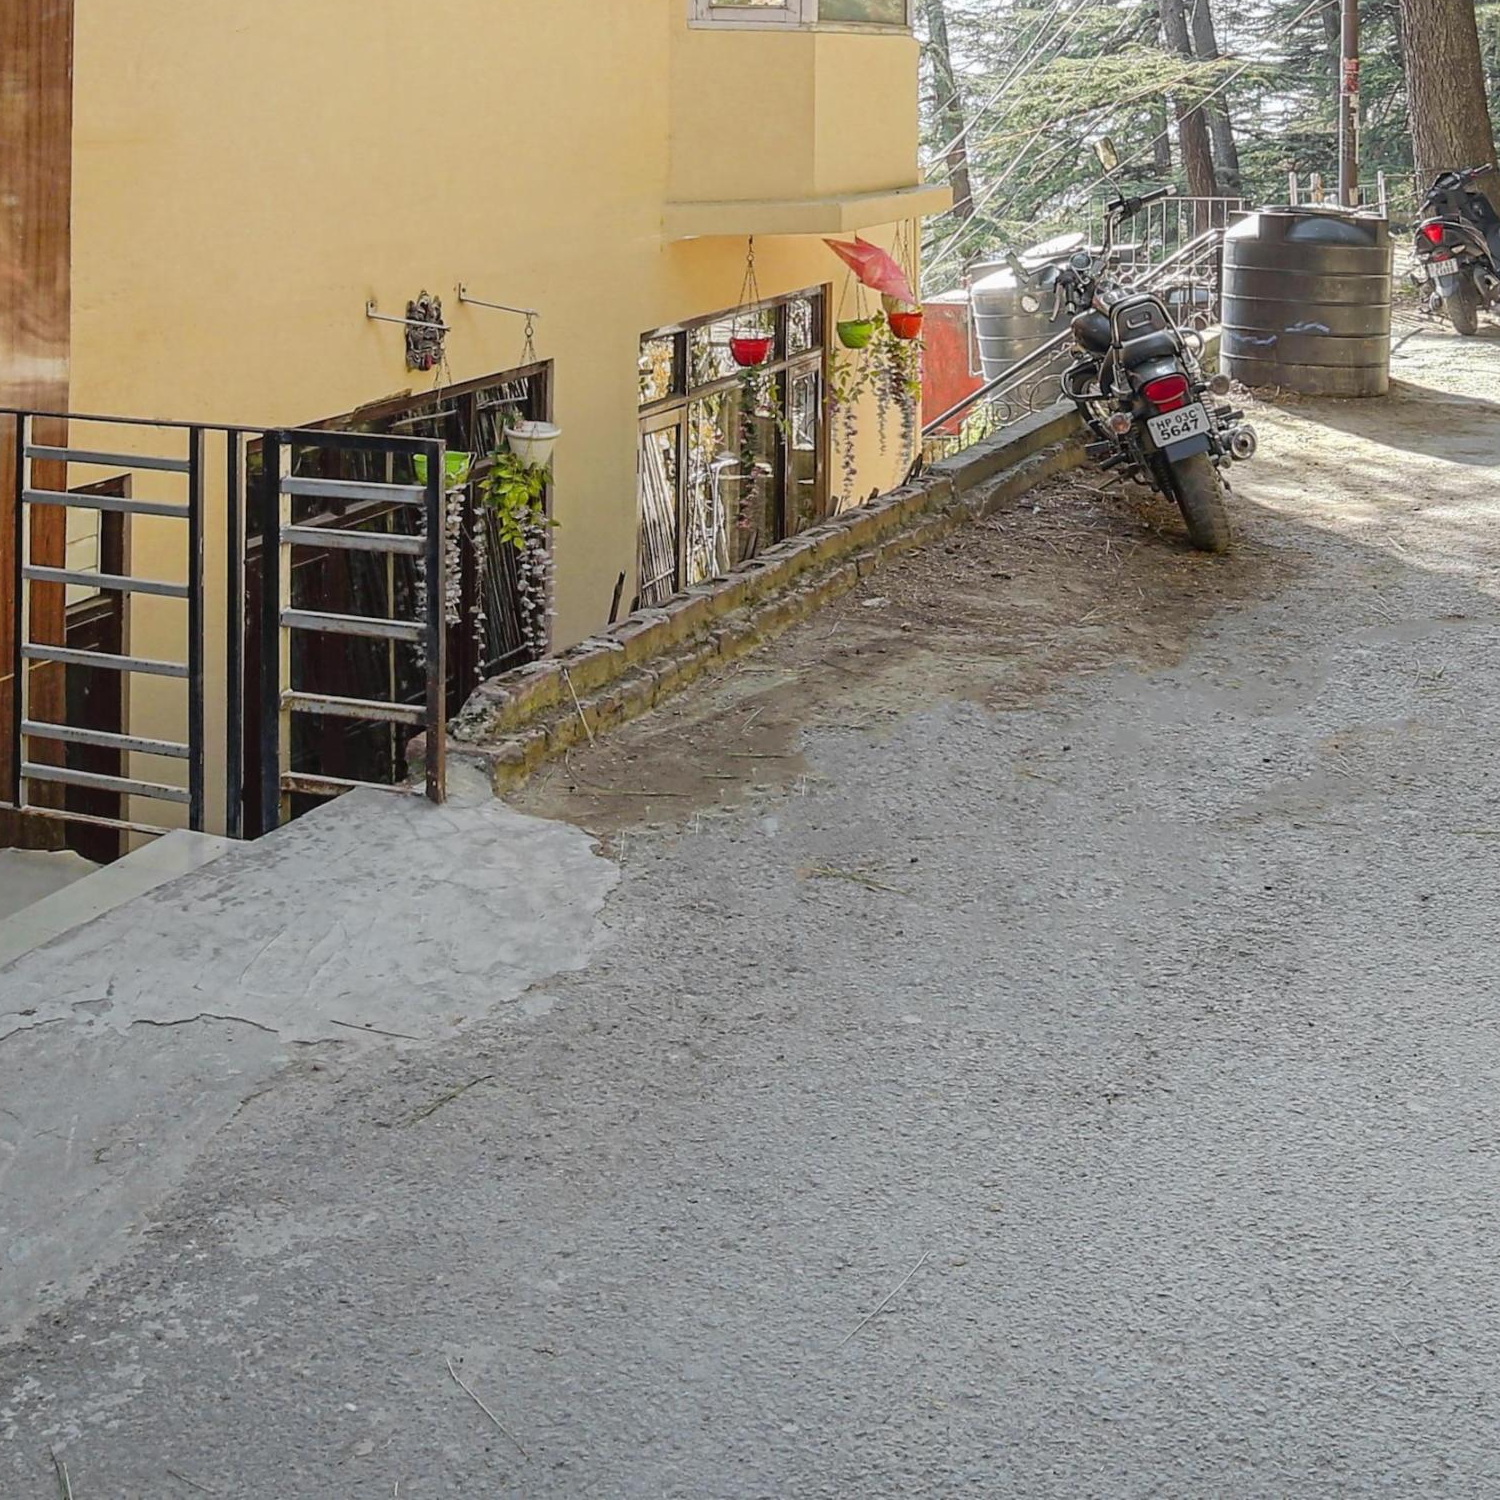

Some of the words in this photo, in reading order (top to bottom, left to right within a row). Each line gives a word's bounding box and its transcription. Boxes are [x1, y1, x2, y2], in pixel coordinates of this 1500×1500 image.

[1156, 418, 1172, 430] HP
[1175, 409, 1197, 423] 03C
[1161, 418, 1199, 440] 5647
